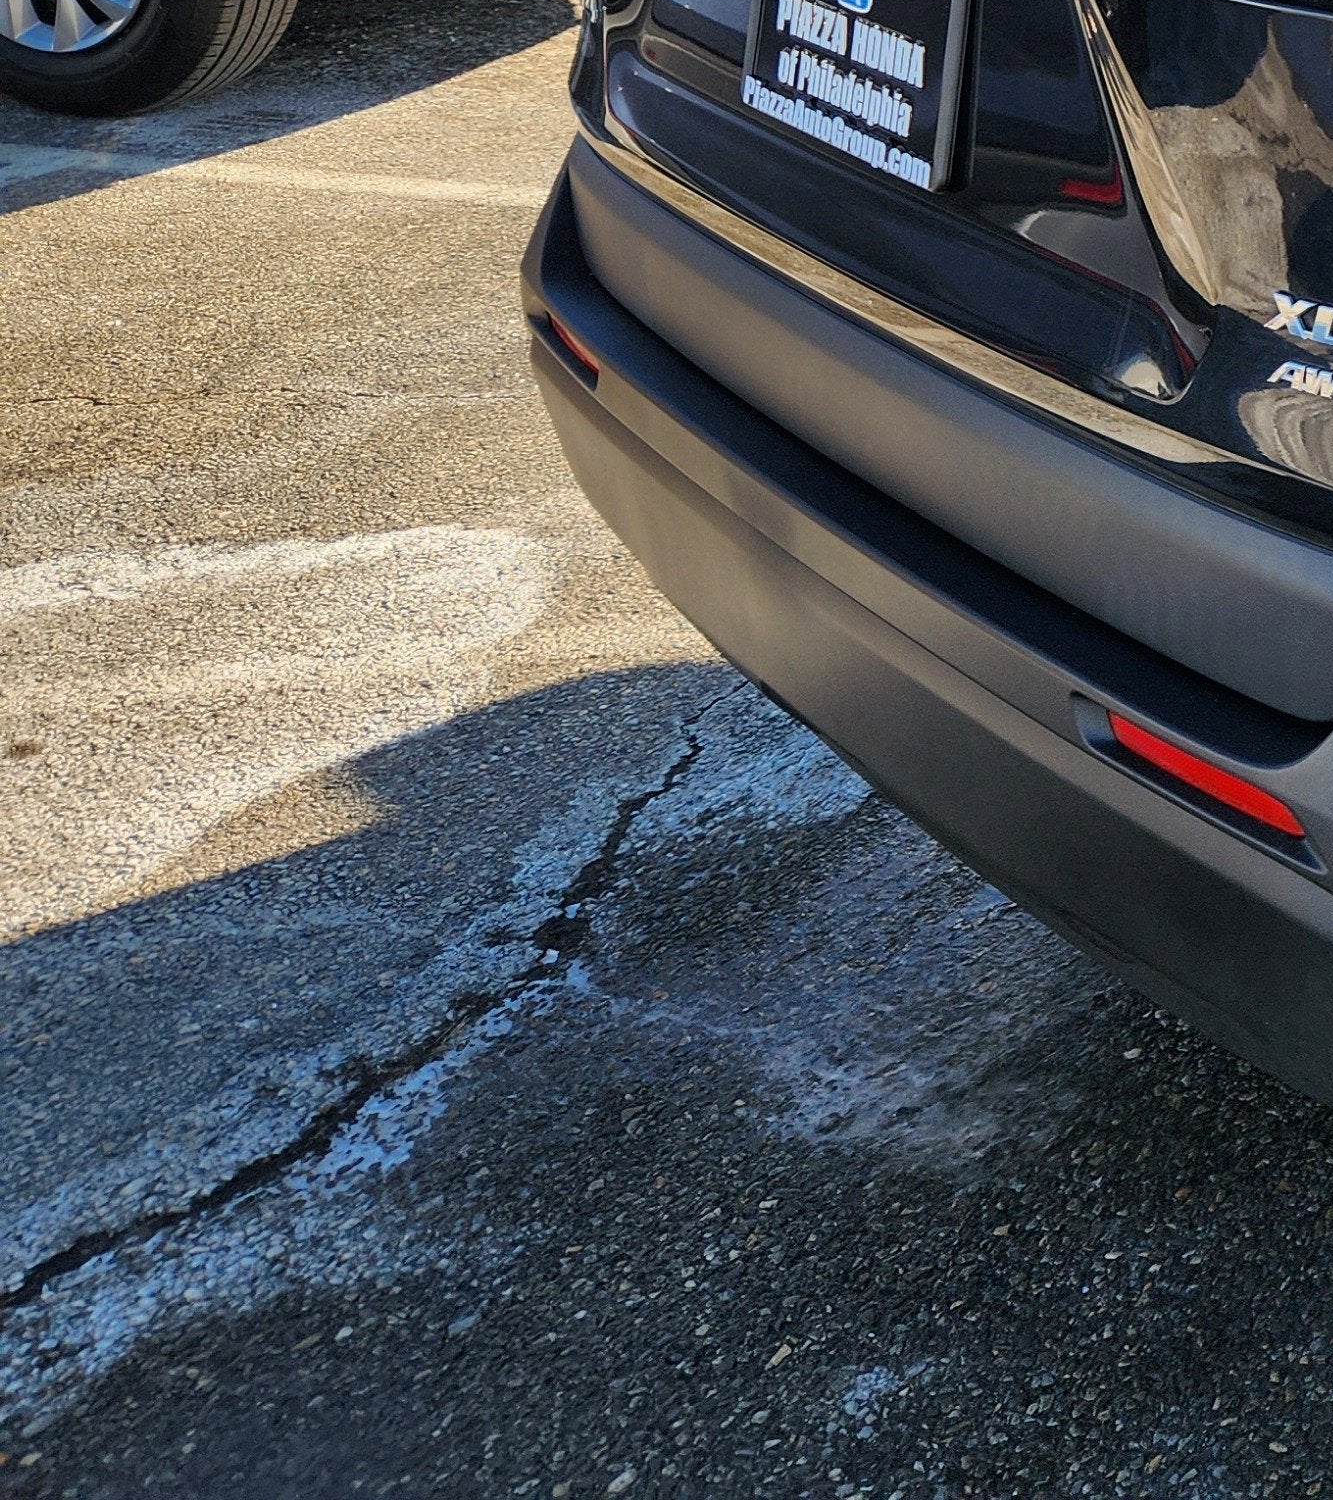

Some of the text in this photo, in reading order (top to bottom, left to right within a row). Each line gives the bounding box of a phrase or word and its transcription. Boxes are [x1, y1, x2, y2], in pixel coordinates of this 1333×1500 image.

[778, 48, 913, 138] of Philadelphia
[851, 16, 926, 88] HONDA
[743, 74, 932, 190] PiazzaAutoGroup.com
